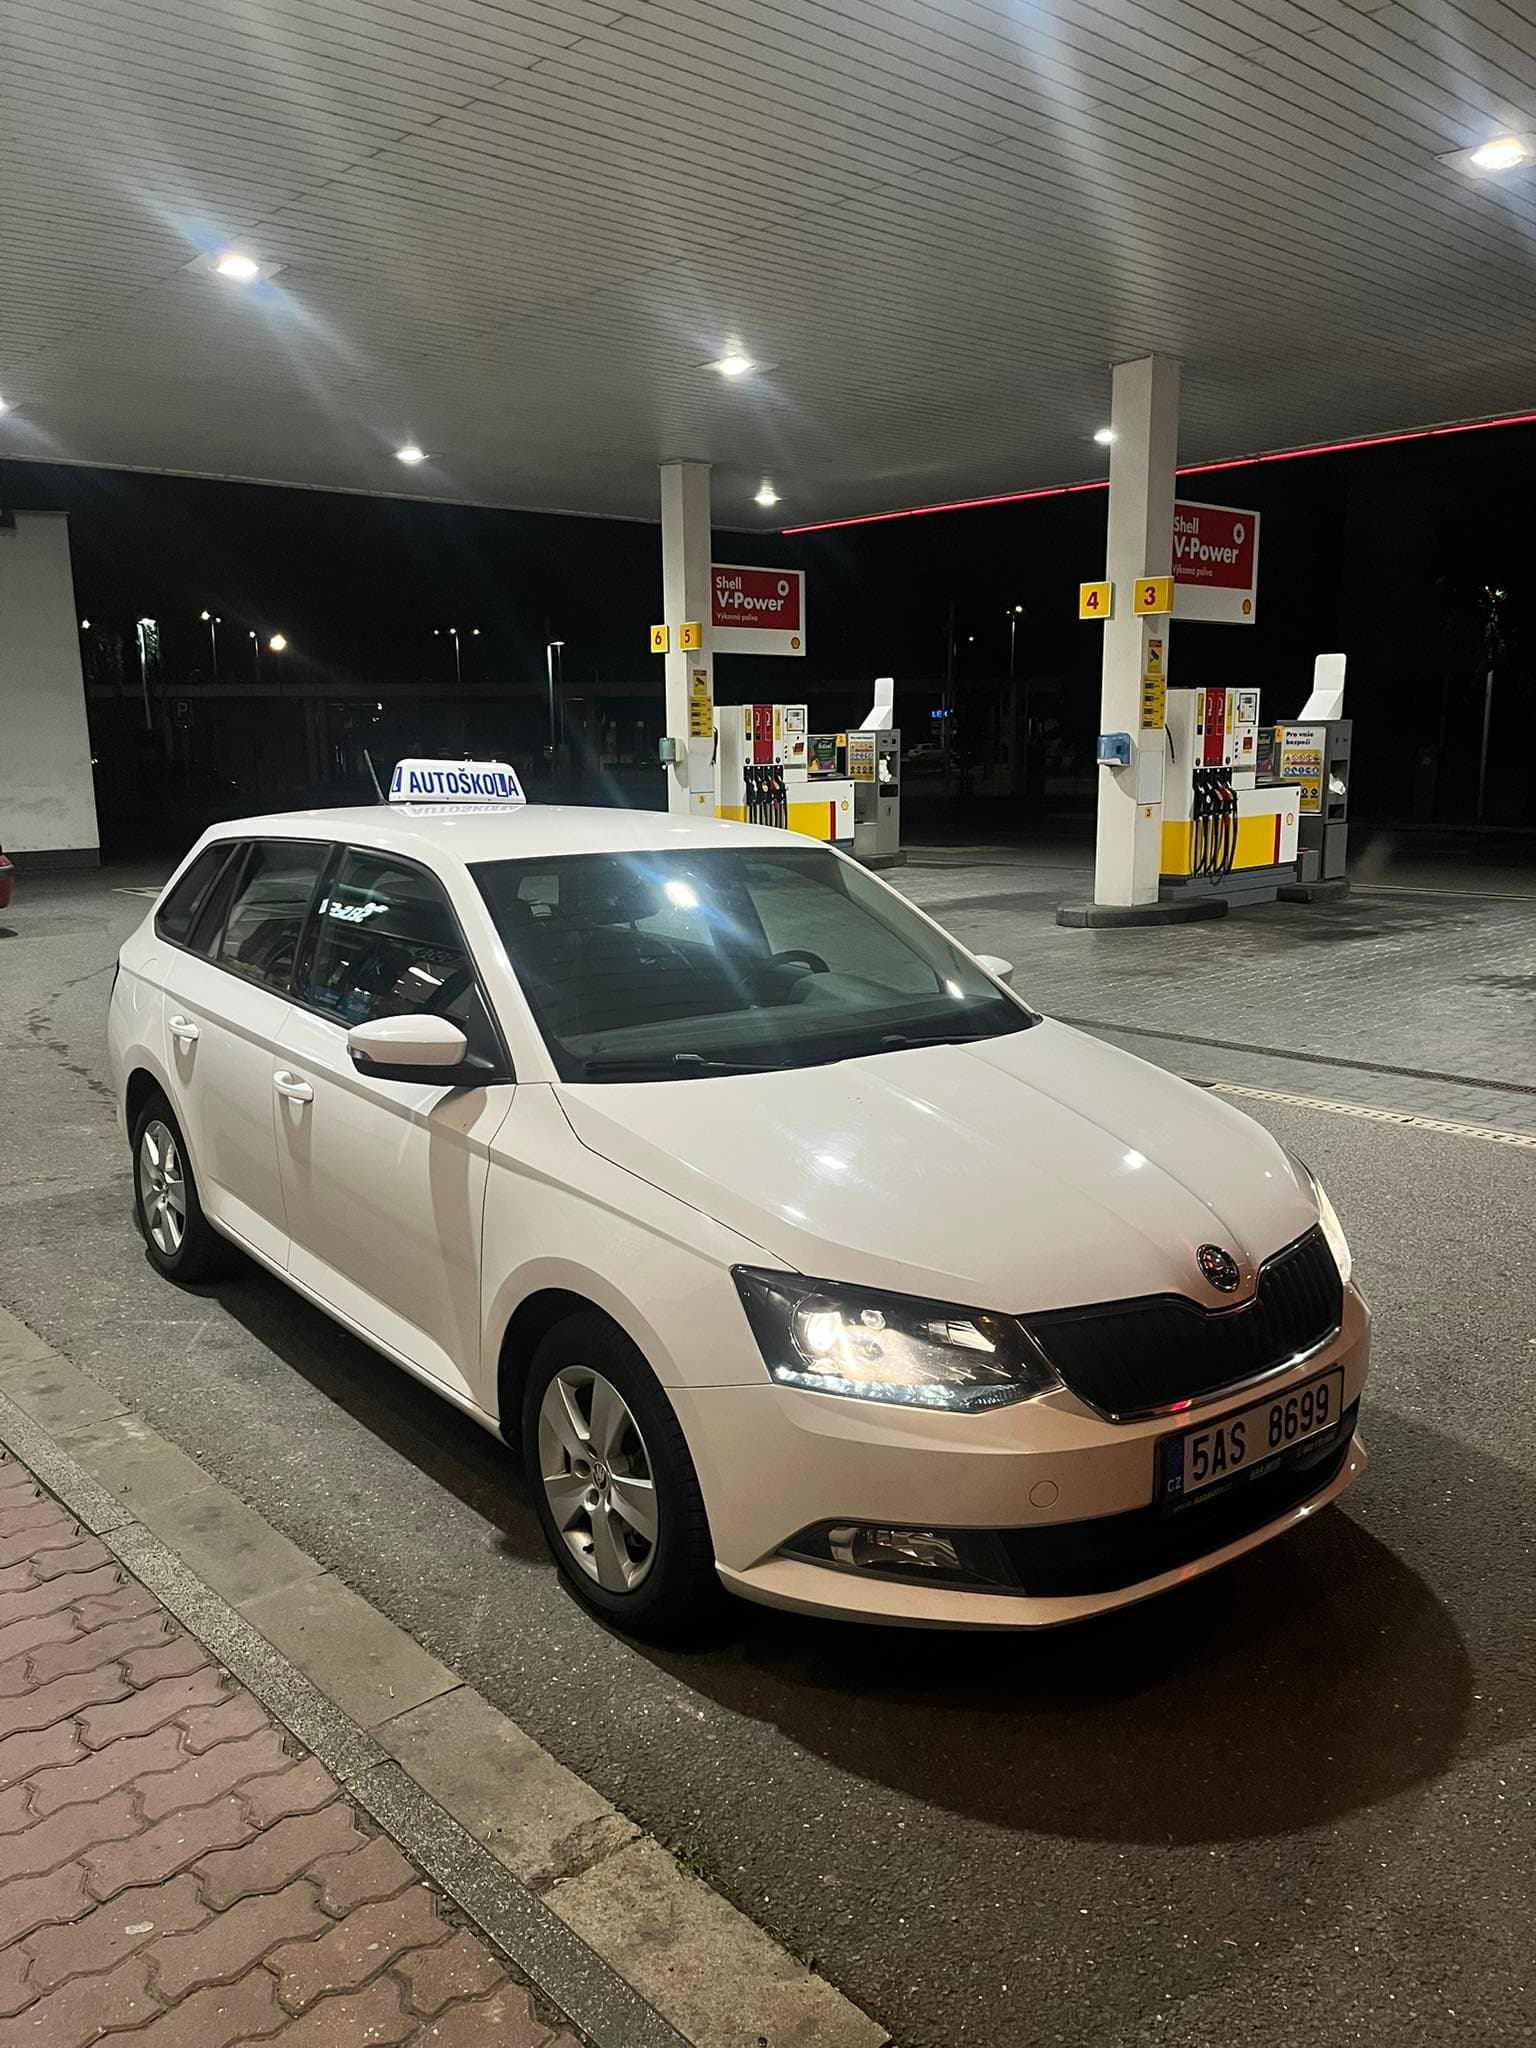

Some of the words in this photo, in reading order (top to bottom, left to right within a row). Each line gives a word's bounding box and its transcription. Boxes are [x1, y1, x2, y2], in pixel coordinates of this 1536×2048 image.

[1173, 515, 1200, 535] Shell
[1173, 535, 1240, 564] V-Power
[715, 575, 742, 590] Shell
[716, 590, 784, 612] V-Power
[1086, 591, 1099, 610] 4
[1143, 586, 1156, 606] 3
[655, 630, 662, 646] 6
[684, 628, 691, 644] 5
[410, 767, 519, 797] AUTOŠKOLA
[1192, 1421, 1246, 1481] 5AS
[1268, 1383, 1329, 1448] 8699
[1167, 1475, 1182, 1493] CZ
